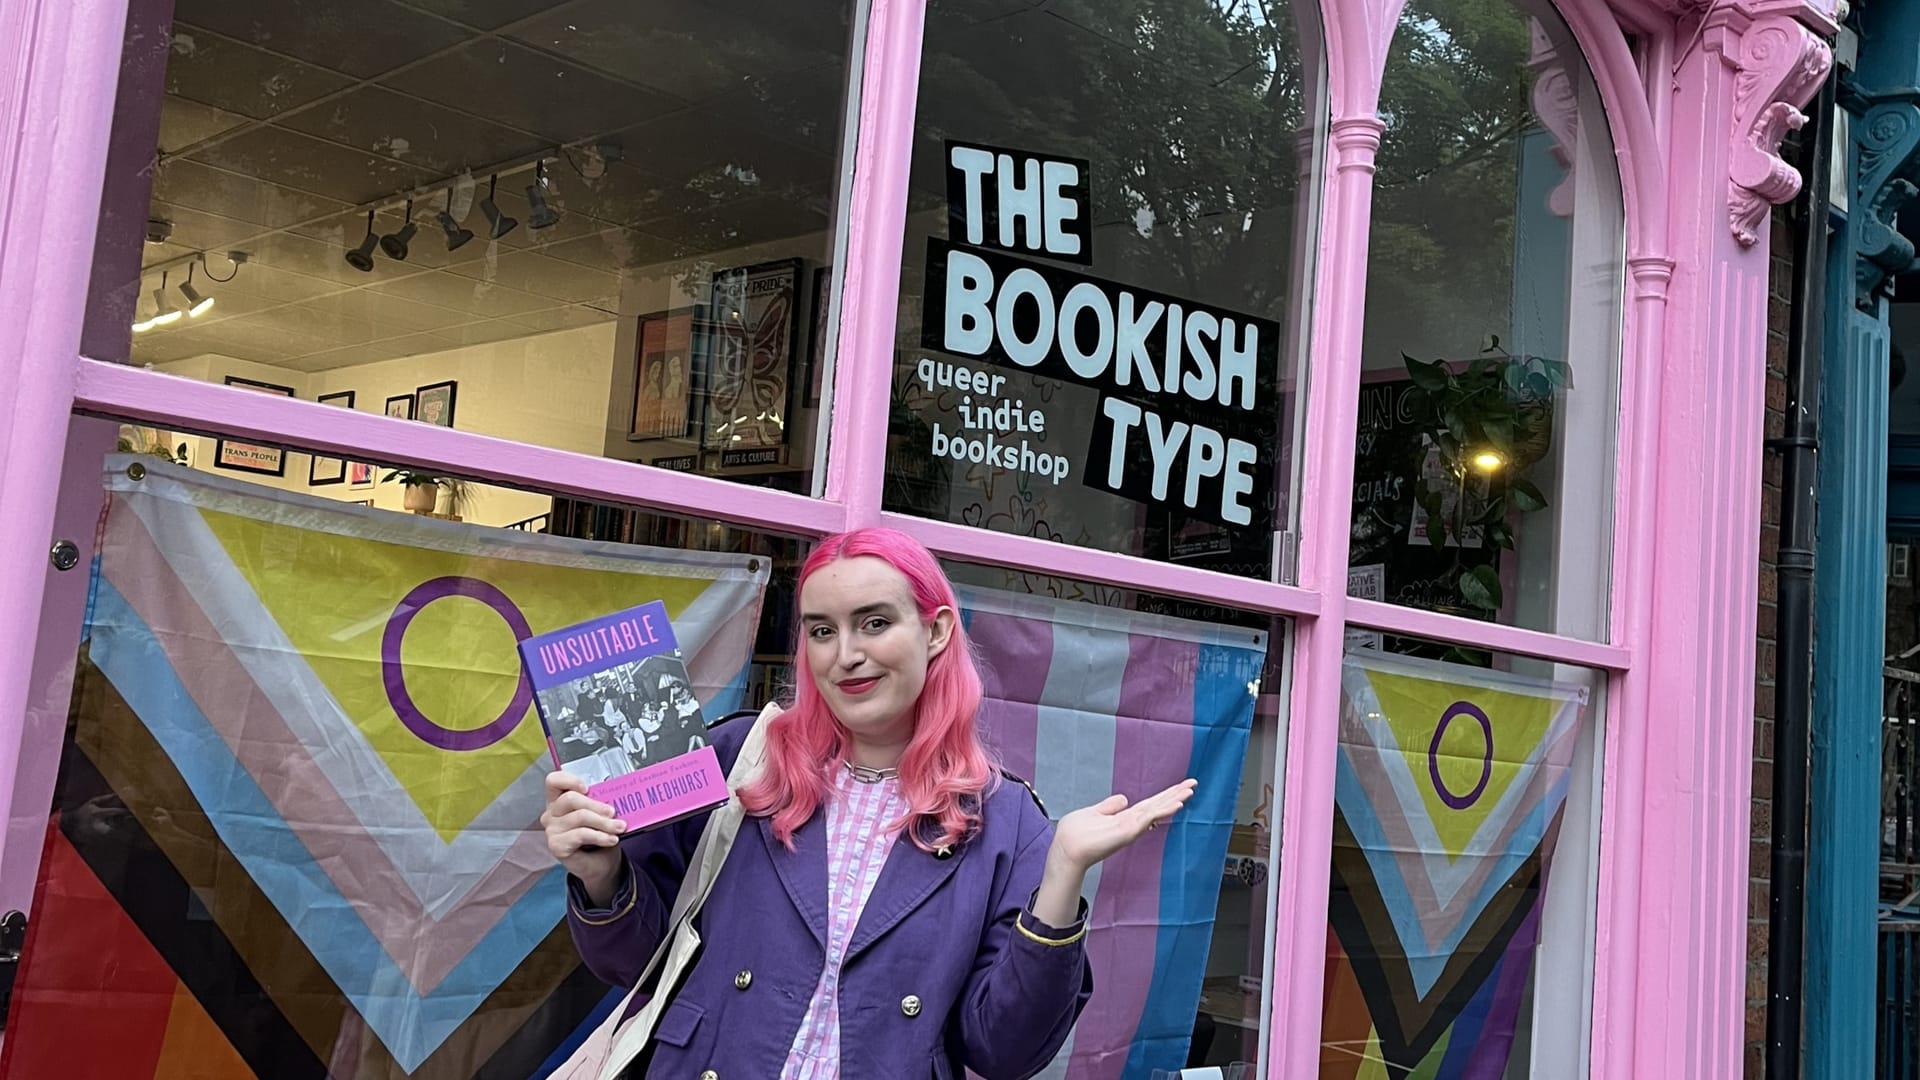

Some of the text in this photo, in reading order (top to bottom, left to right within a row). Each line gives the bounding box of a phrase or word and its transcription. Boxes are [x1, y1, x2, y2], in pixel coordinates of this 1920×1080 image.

[951, 146, 1081, 255] THE
[728, 282, 749, 297] GAY
[752, 277, 786, 293] PRIDE
[944, 250, 1259, 411] BOOKISH
[917, 359, 1006, 398] queer
[958, 396, 1045, 433] indie
[225, 448, 277, 462] TRANS PEOPLE
[724, 451, 777, 465] ARTS & CULTURE
[932, 424, 1070, 485] bookshop
[1103, 397, 1258, 527] TYPE
[1354, 475, 1404, 503] CIALS
[1360, 586, 1376, 597] LAB
[539, 614, 659, 675] UNSUITABLE
[605, 768, 710, 817] ANOR MEDHURST
